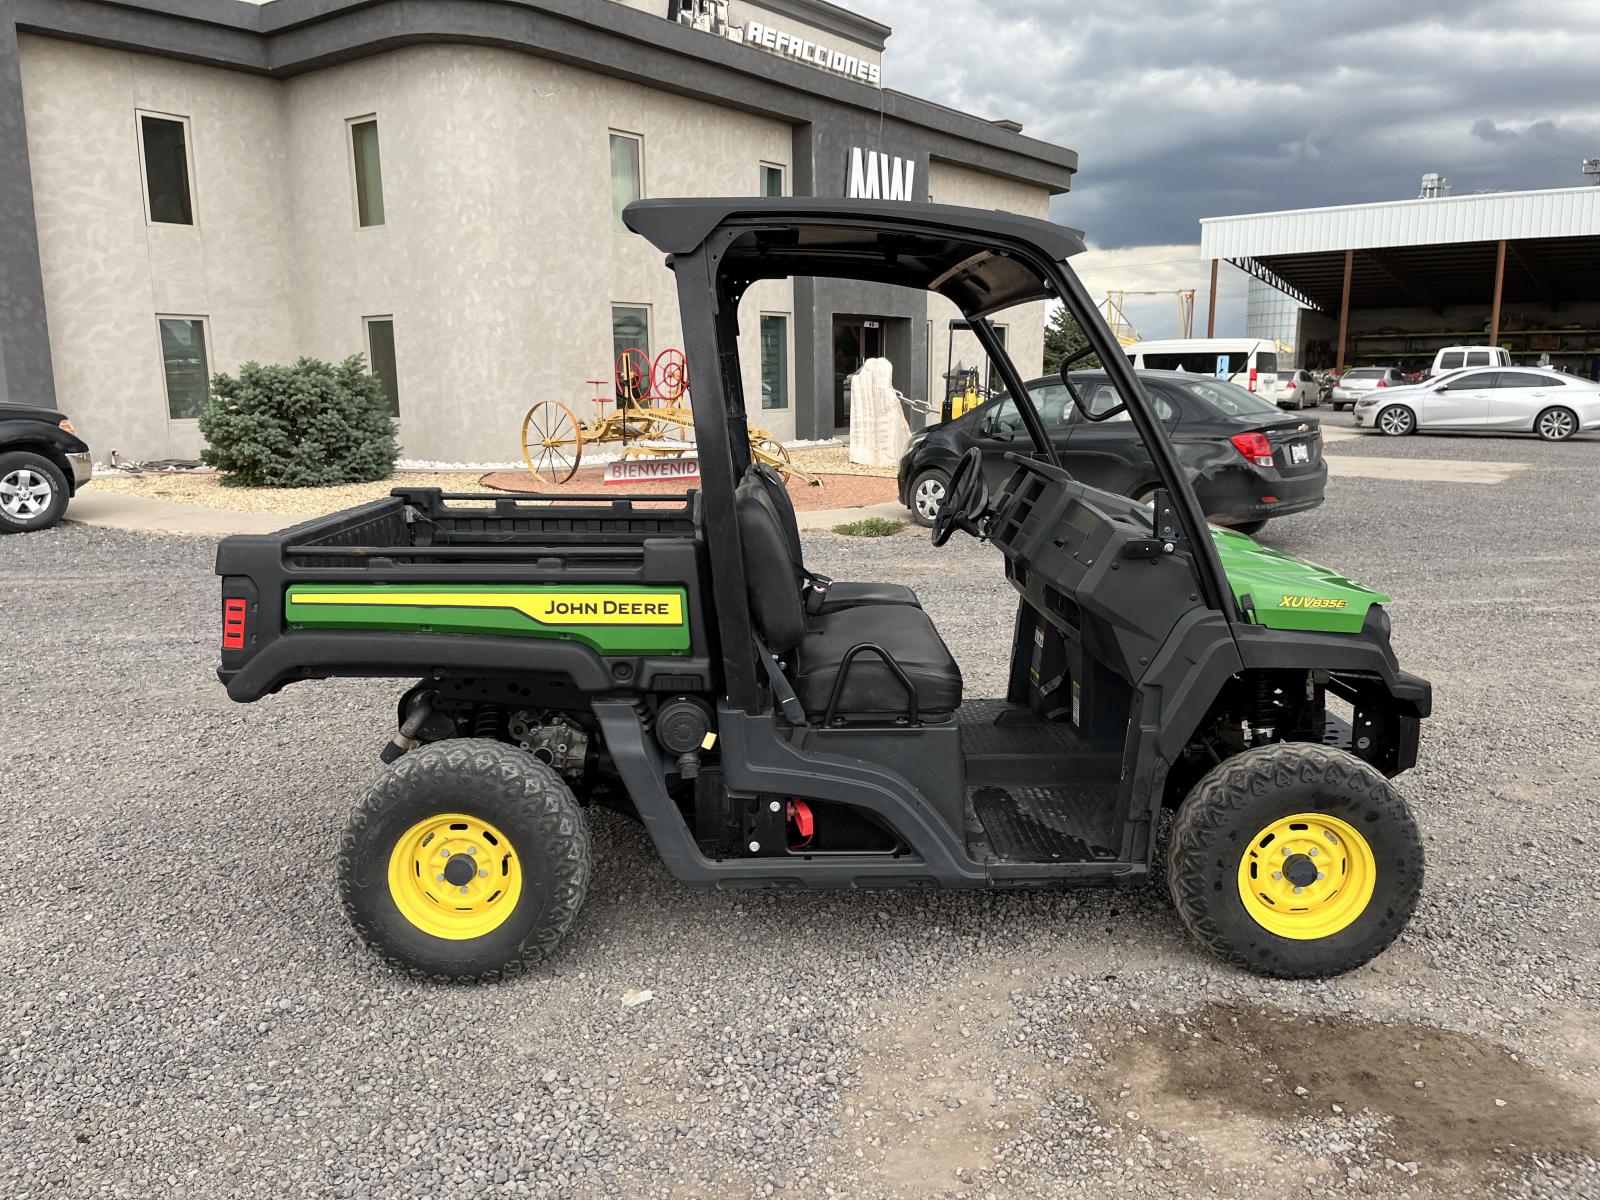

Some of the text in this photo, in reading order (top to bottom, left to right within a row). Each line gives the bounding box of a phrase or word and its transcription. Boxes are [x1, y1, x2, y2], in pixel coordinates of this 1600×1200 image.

[747, 20, 880, 82] REFACCIONES
[612, 461, 700, 478] BIENVENID
[544, 600, 669, 615] JOHN DEERE
[1278, 595, 1348, 608] XUV835E
